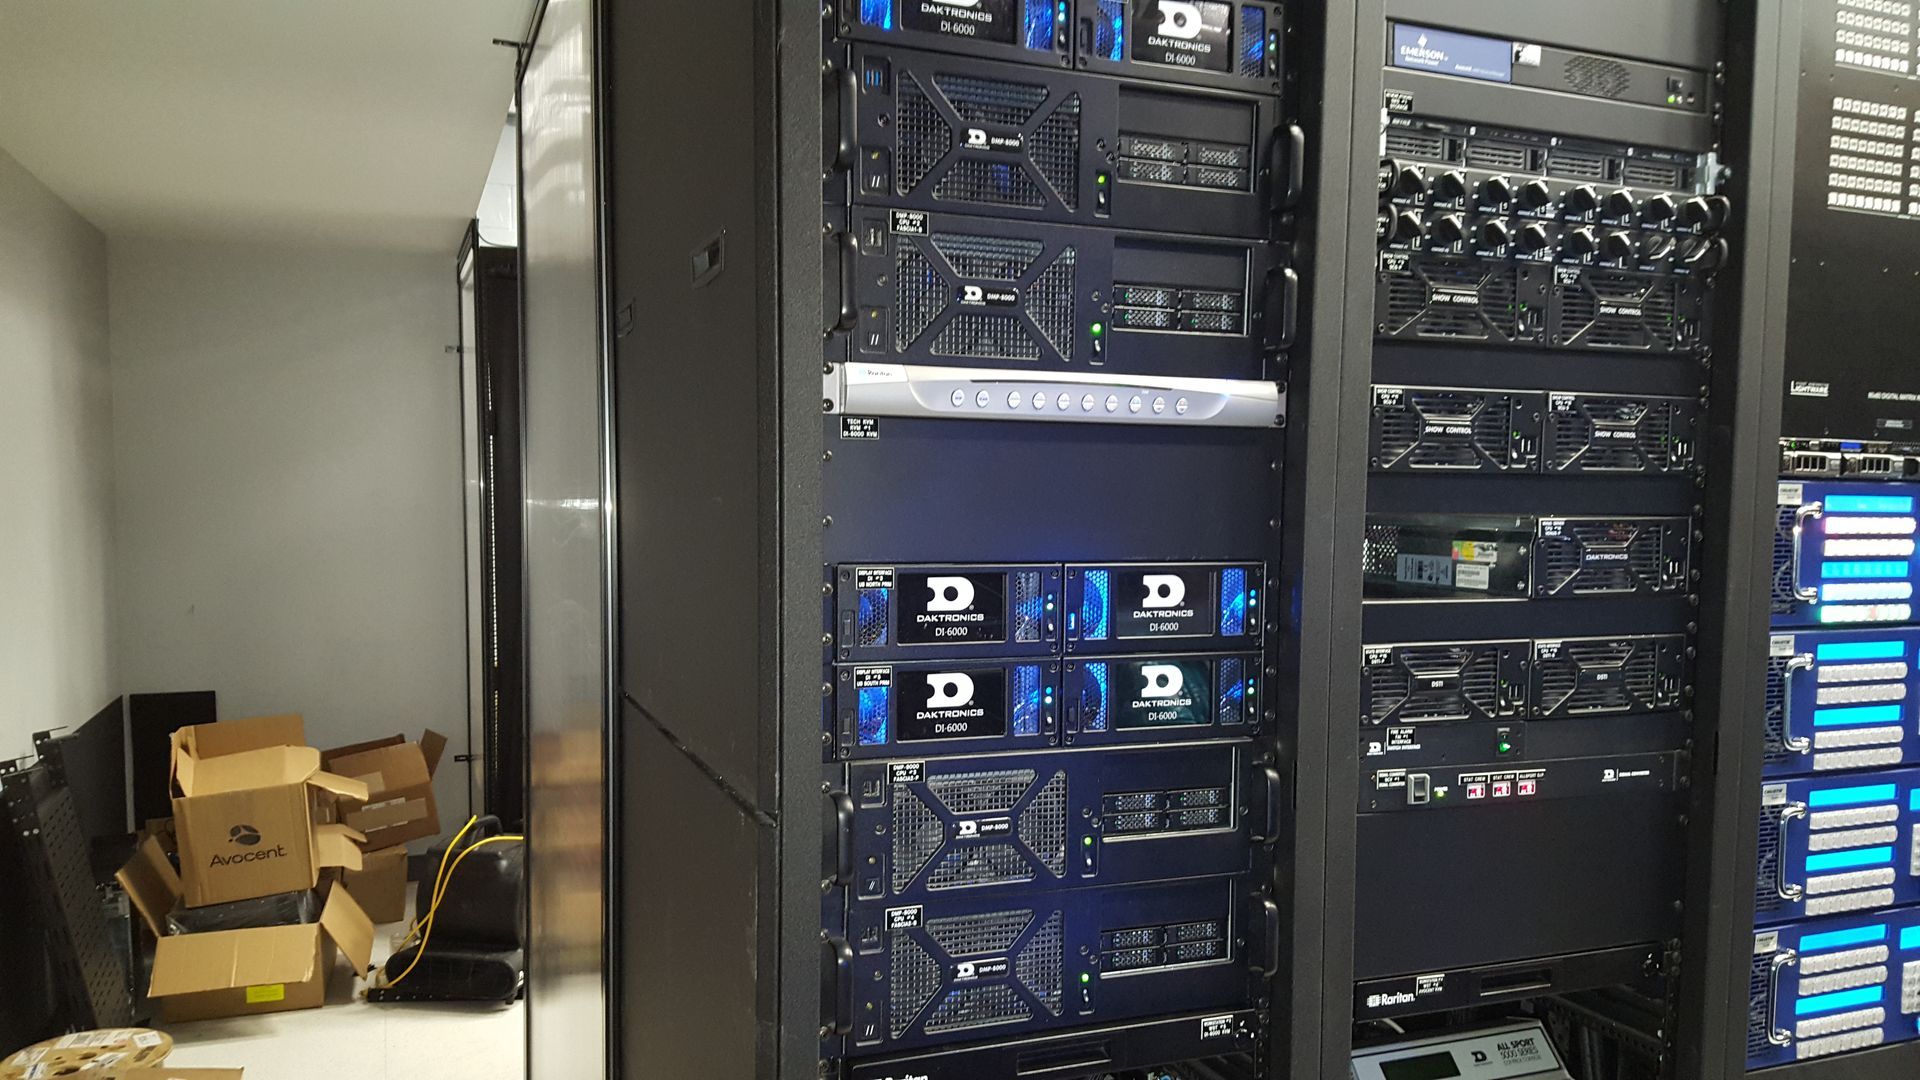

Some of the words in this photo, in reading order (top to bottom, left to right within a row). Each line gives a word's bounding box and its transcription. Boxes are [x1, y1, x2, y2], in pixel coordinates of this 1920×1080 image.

[921, 2, 992, 22] DAKTRONICS
[1148, 36, 1211, 53] DAKTRONICS
[1432, 294, 1450, 302] SHOW
[1452, 295, 1479, 304] CONTROL
[916, 613, 984, 623] DAKTRONICS
[1133, 610, 1193, 618] DAKTRONICS
[935, 627, 968, 636] DI-6000
[1150, 622, 1179, 632] DI-6000
[1132, 698, 1191, 708] DAKTRONICS
[916, 708, 984, 720] DAKTRONICS
[1148, 712, 1177, 721] DI-6000
[935, 723, 968, 733] DI-6000
[210, 844, 286, 868] Avocent
[1497, 1042, 1510, 1051] ALL
[1511, 1037, 1534, 1048] SPORT
